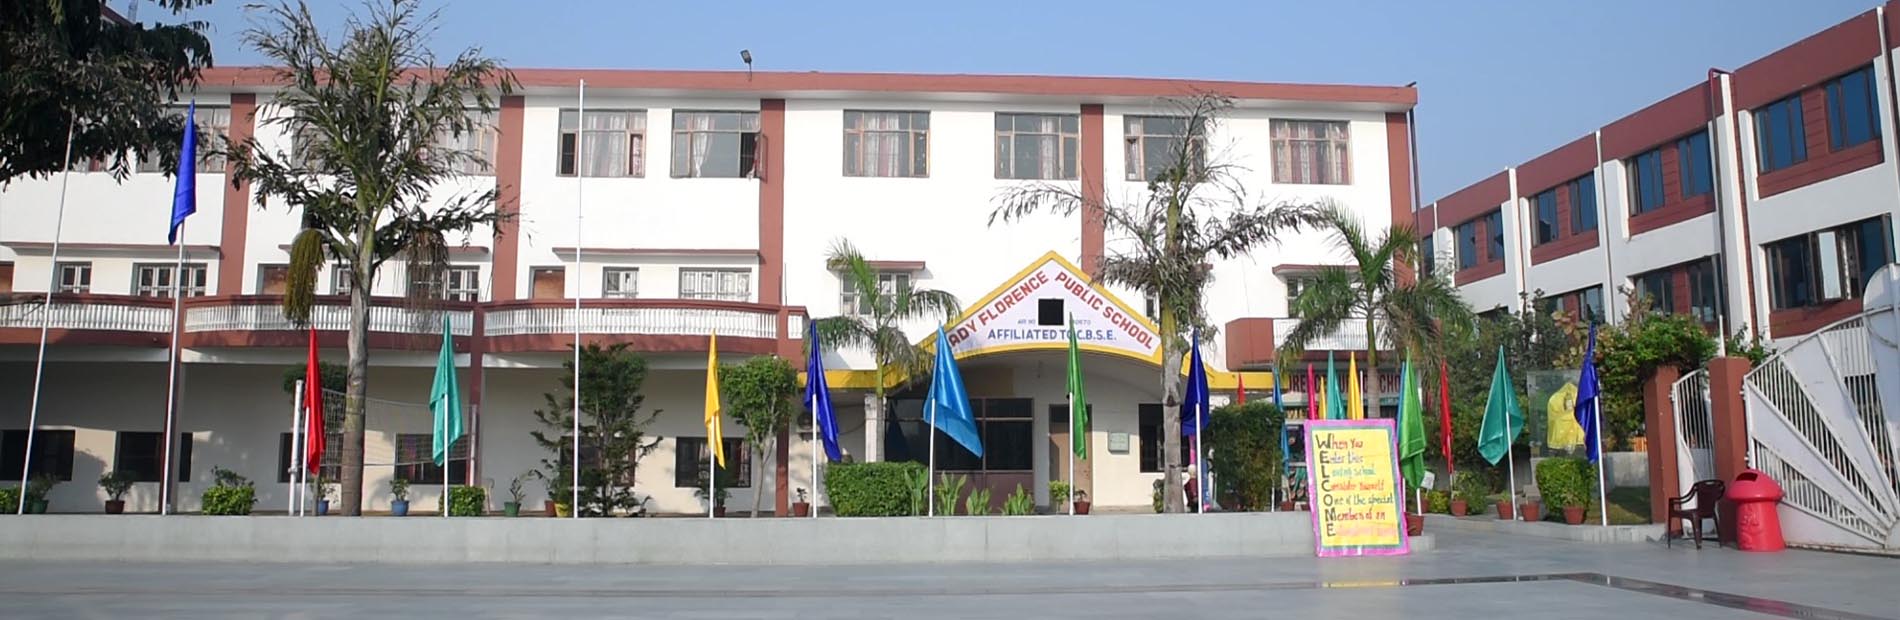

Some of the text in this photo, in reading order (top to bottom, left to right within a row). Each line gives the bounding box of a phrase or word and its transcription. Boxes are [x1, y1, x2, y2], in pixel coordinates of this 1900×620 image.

[947, 270, 1153, 350] ADY FLORENCE PUBLIC SCHOOL
[987, 329, 1057, 341] AFFILIATED
